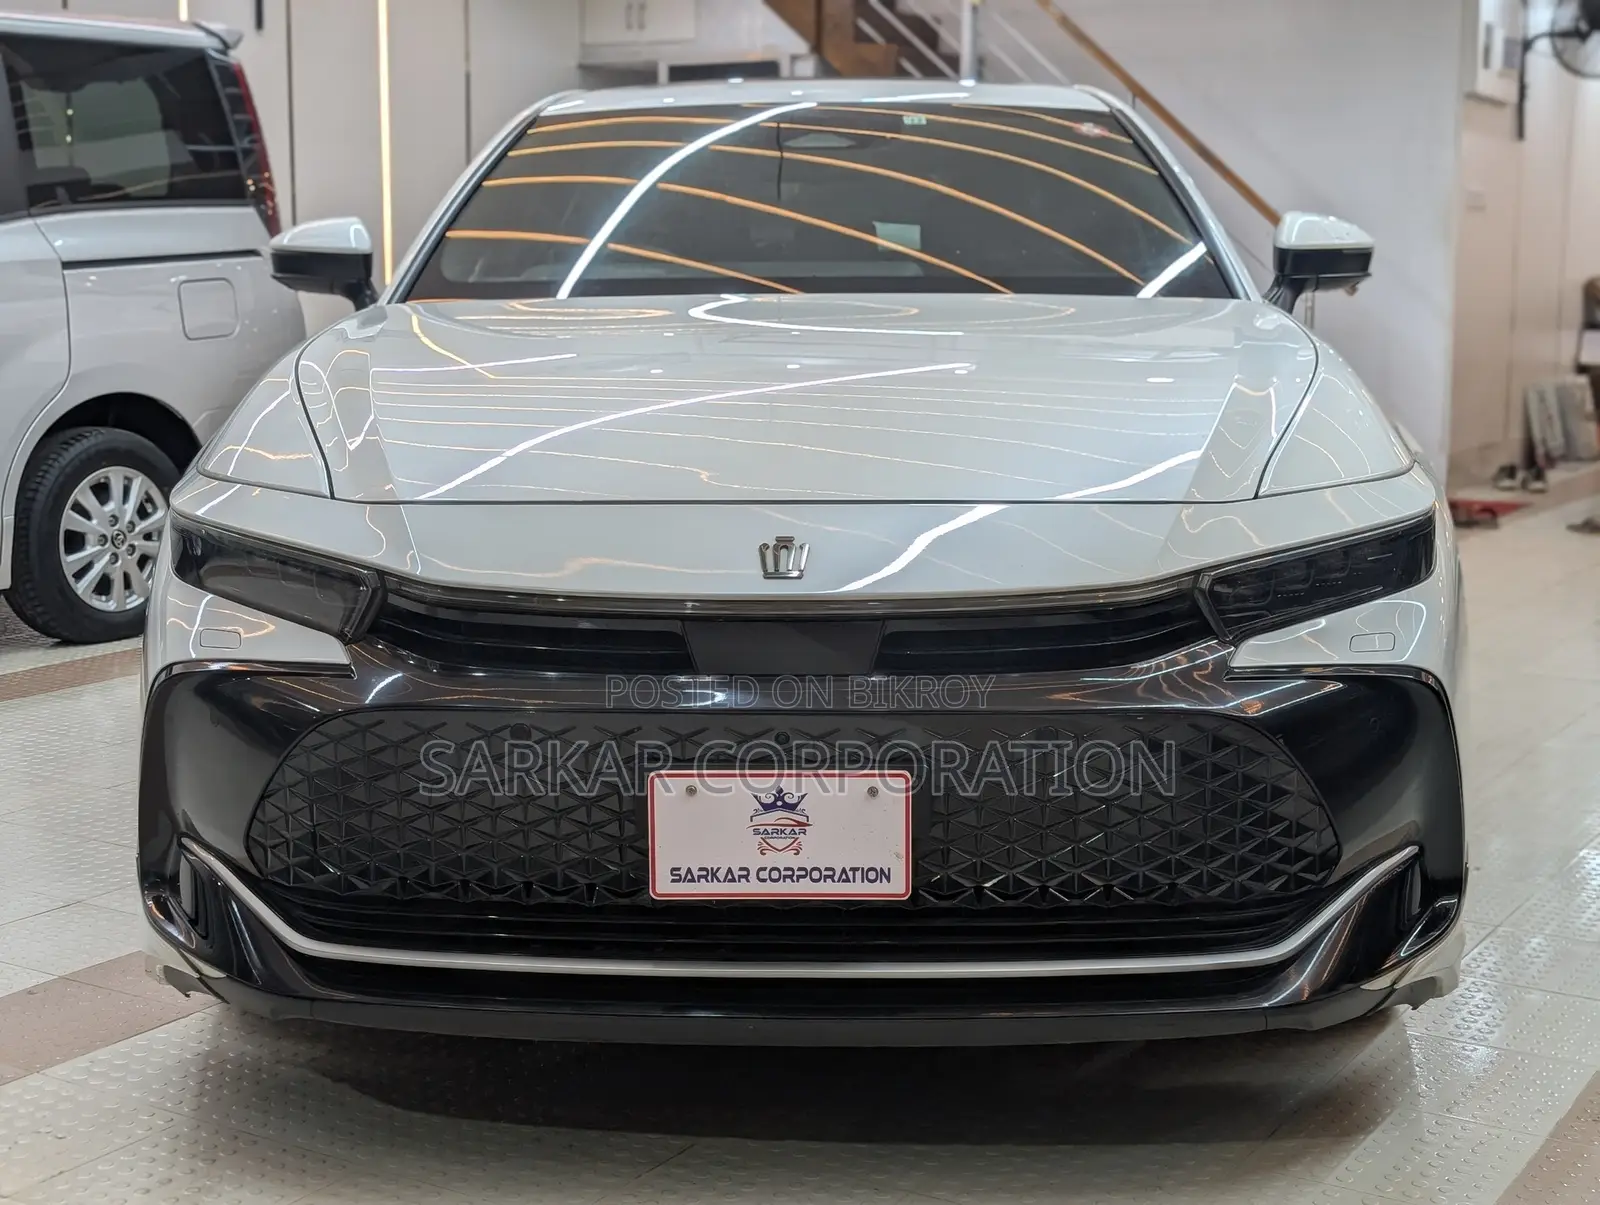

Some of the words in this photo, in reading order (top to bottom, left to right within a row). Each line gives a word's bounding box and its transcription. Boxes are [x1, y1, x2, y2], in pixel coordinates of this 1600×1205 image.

[752, 827, 807, 836] SARKAR
[669, 866, 751, 884] SARKAR
[755, 866, 892, 884] CORPORATION
